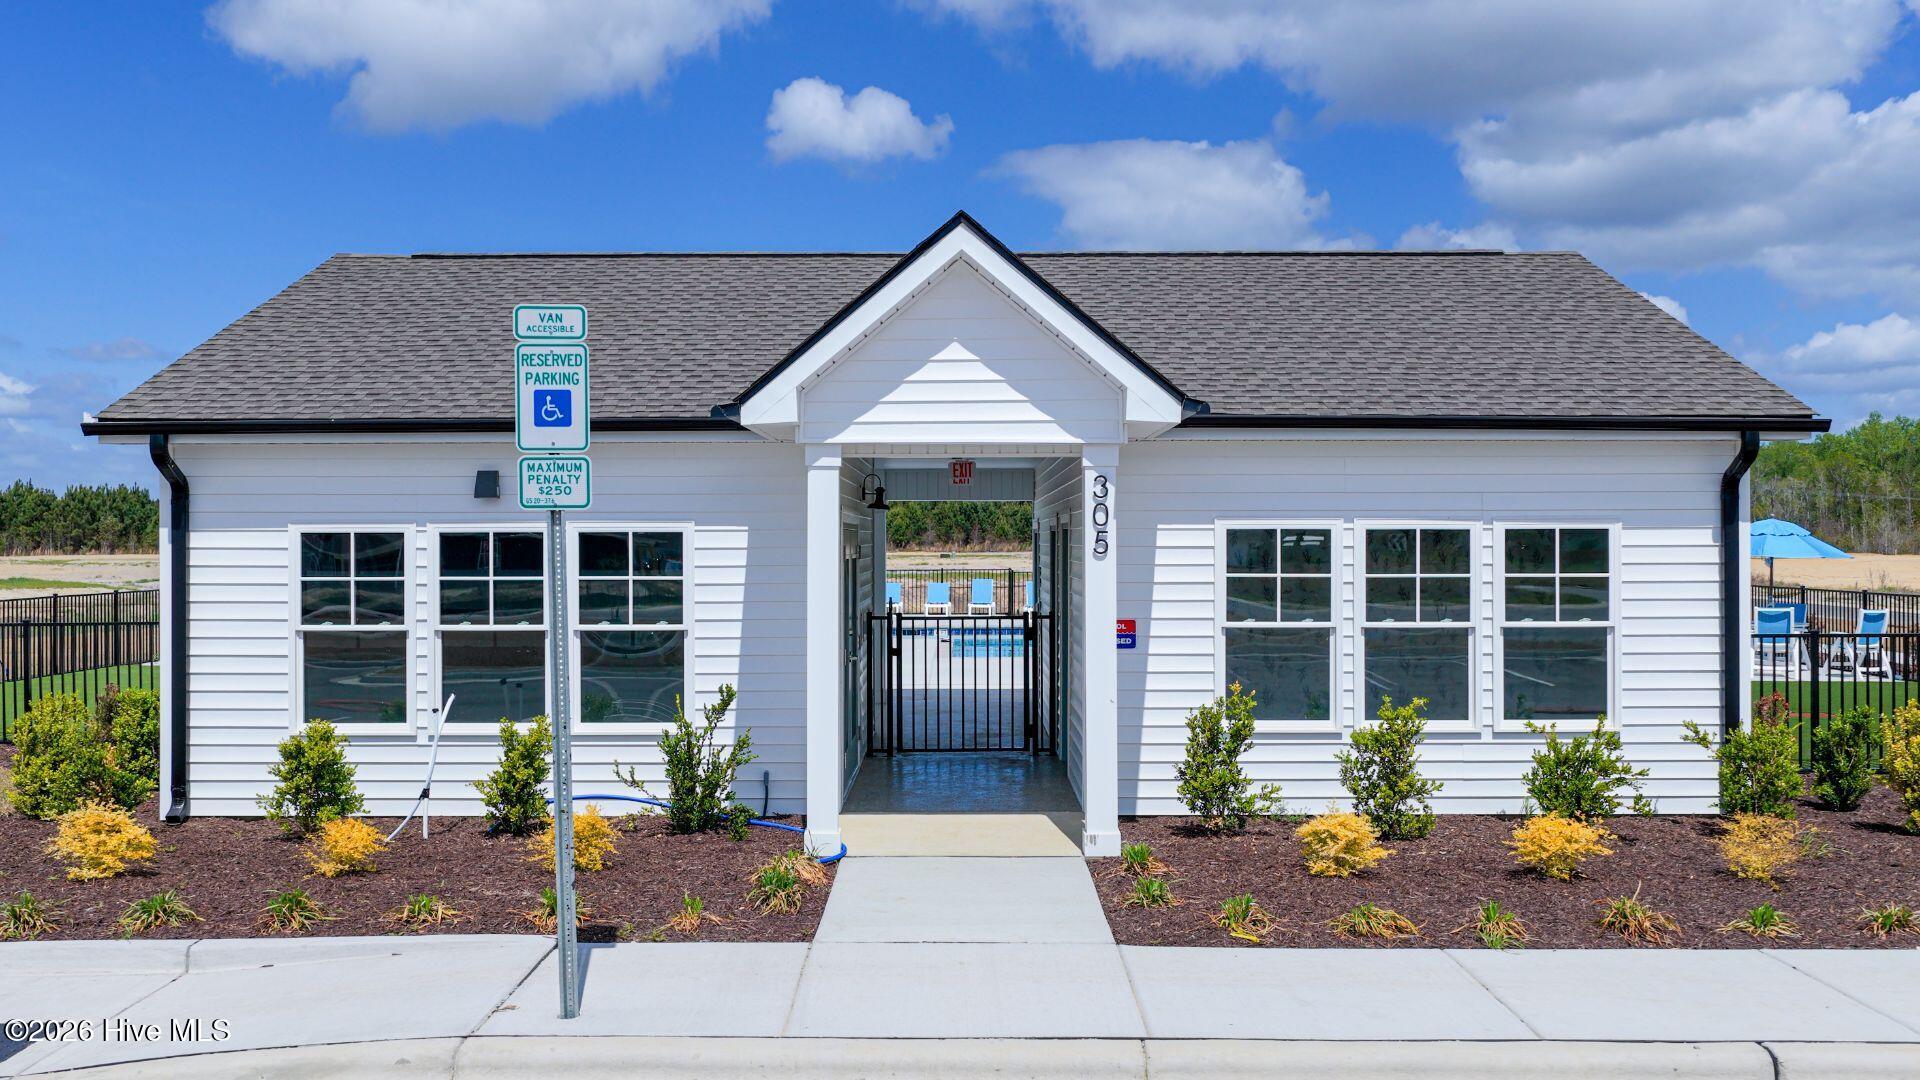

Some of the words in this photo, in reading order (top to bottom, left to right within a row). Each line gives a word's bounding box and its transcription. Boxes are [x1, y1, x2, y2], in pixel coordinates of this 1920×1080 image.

[539, 313, 563, 323] VAN
[526, 325, 575, 333] ACCESSIBLE
[521, 353, 583, 367] RESERVED
[525, 372, 580, 386] PARKING
[527, 463, 582, 472] MAXIMUM
[952, 462, 973, 478] EXIT
[528, 475, 580, 484] PENALTY
[539, 486, 572, 495] $250
[1093, 475, 1109, 554] 305
